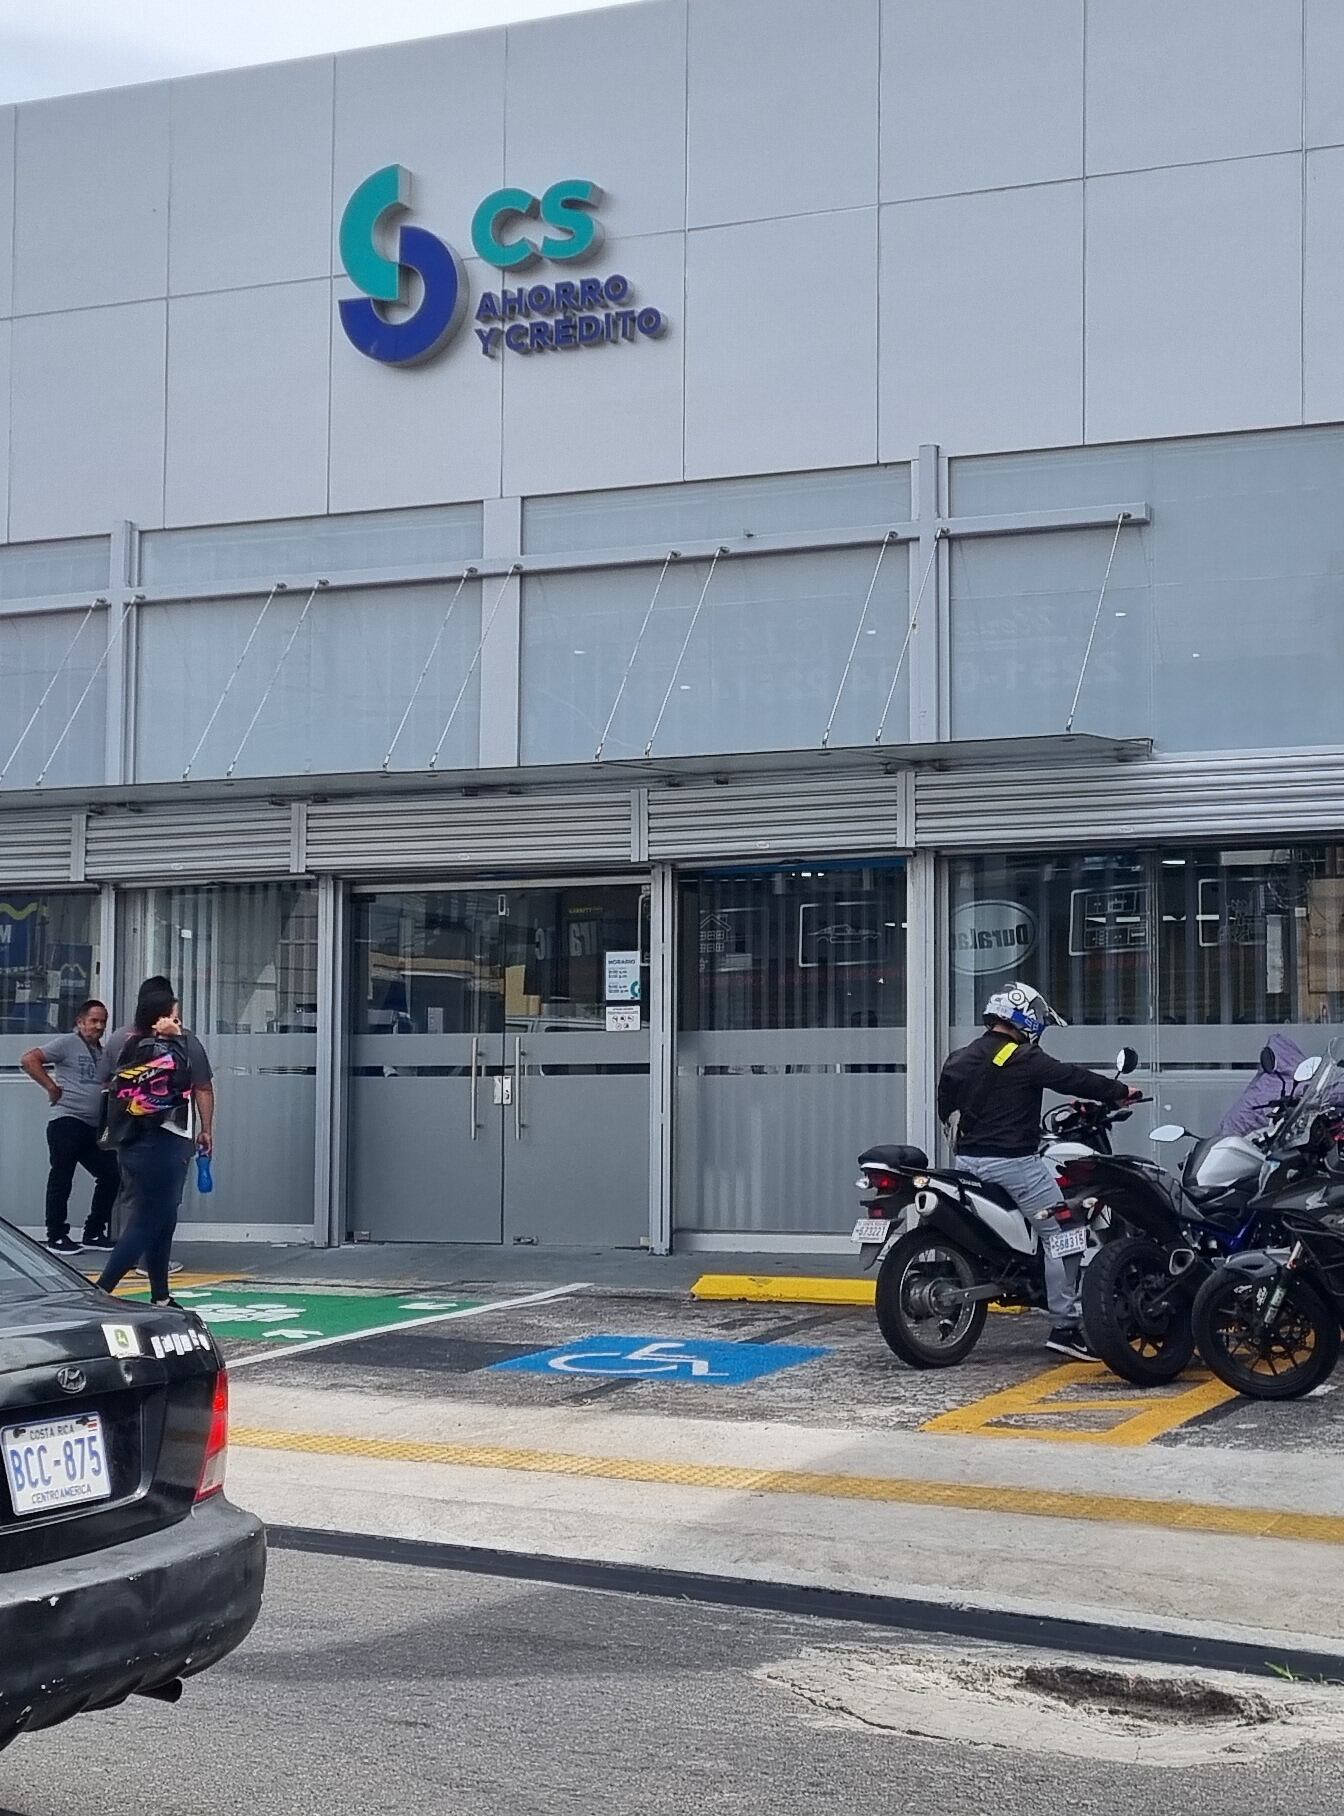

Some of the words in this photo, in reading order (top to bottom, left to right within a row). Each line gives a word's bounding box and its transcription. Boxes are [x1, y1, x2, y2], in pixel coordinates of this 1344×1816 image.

[470, 179, 602, 269] CS
[475, 273, 632, 322] AHORRO
[474, 326, 503, 356] Y
[504, 306, 664, 354] CRÉDITO
[29, 1428, 55, 1441] COSTA
[58, 1424, 75, 1435] RICA
[9, 1435, 102, 1492] BCC-875
[31, 1484, 92, 1504] CENTROAMERICA
